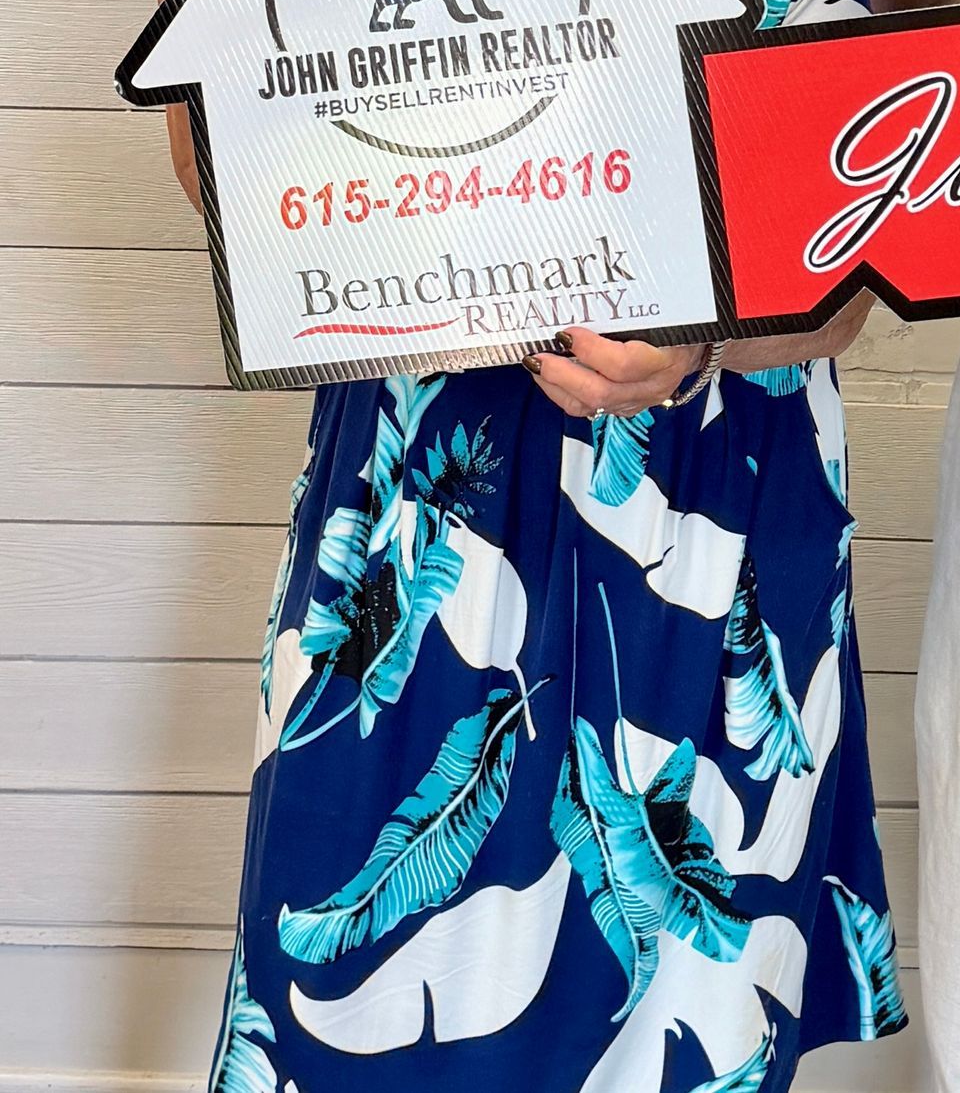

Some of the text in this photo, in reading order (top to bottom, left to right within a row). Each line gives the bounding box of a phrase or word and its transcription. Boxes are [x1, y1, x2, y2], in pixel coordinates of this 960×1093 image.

[258, 18, 620, 100] JOHN GRIFFIN REALTOR
[314, 72, 569, 118] #BUYSELLRENTINVEST
[280, 149, 632, 230] 615-294-4616
[295, 235, 636, 317] Benchmark
[460, 288, 660, 336] REALTY LLC
